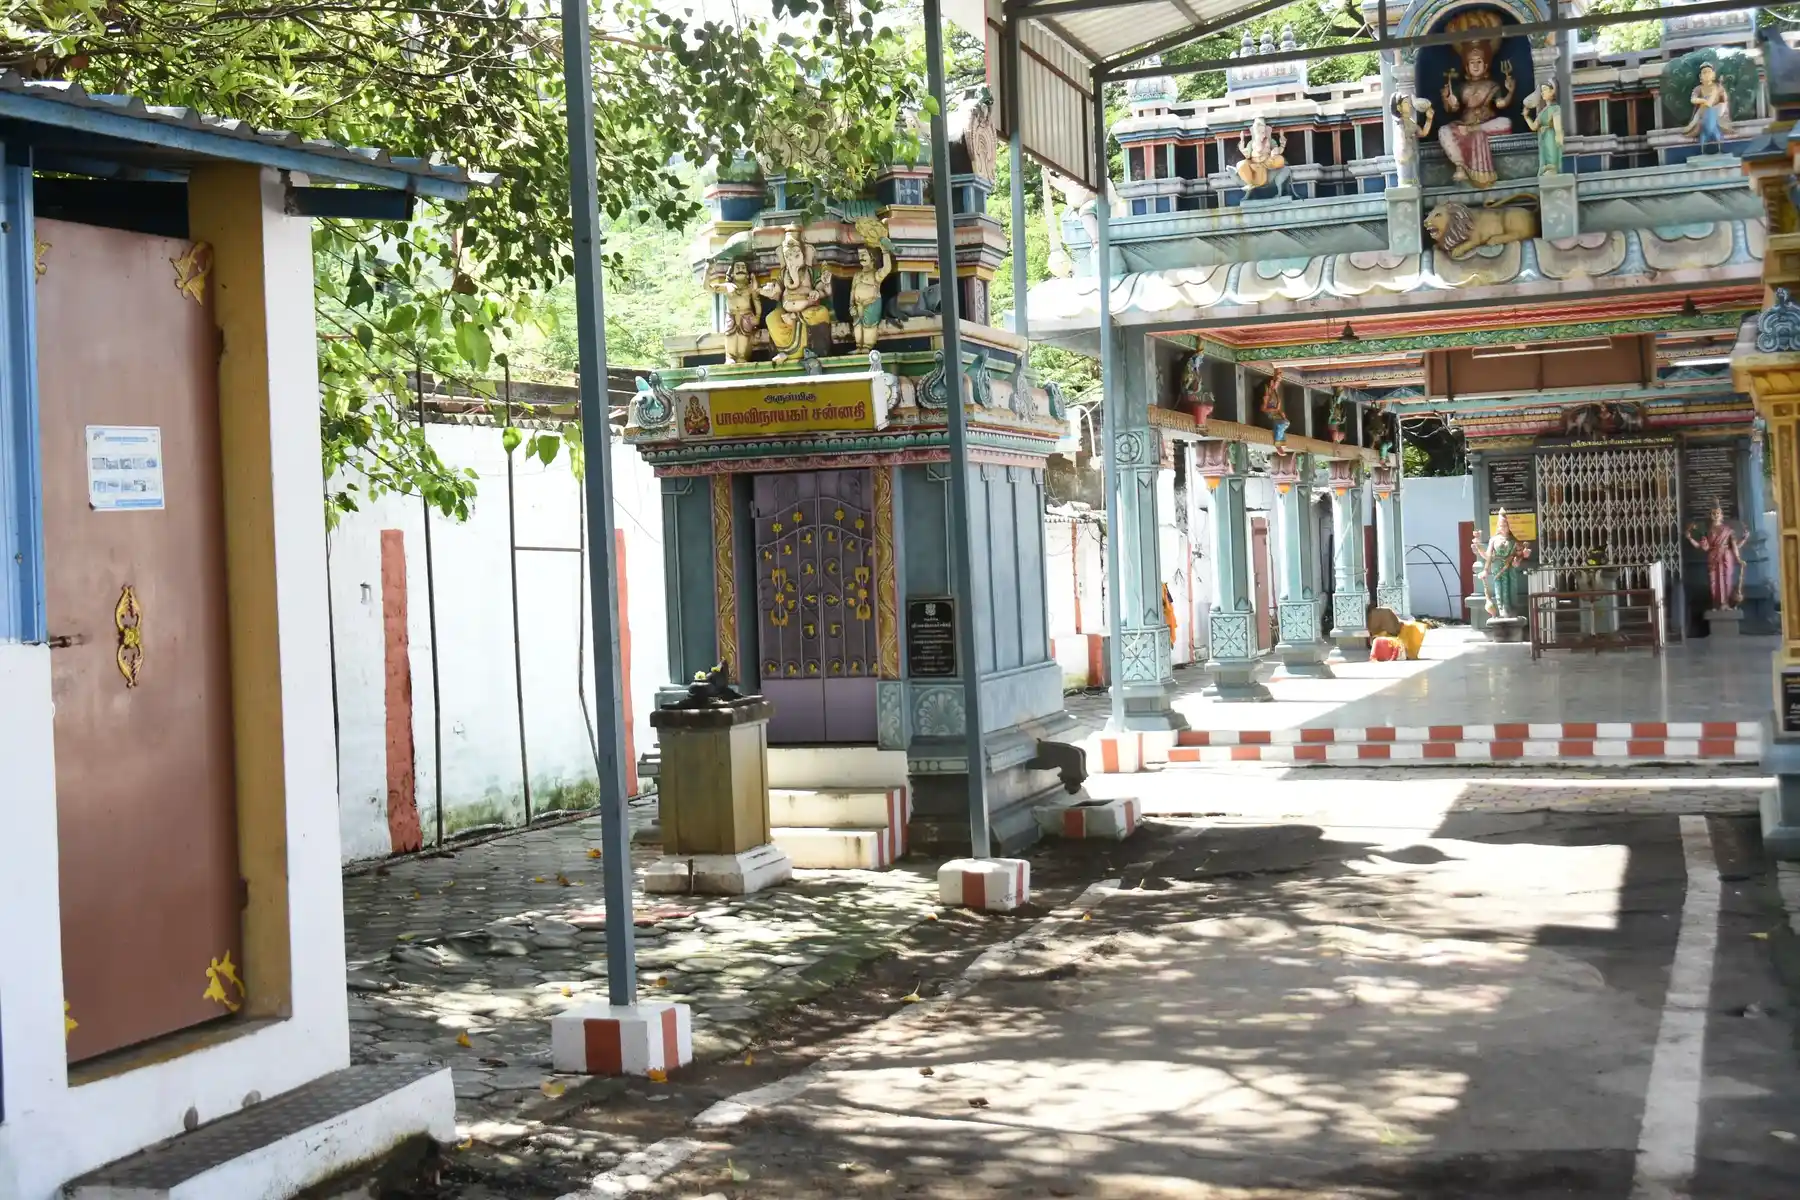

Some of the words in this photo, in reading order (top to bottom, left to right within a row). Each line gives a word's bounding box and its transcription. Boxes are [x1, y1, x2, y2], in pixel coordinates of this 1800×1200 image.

[764, 391, 816, 404] அருள்மிகு
[716, 405, 808, 427] பாலவிநாயகர்
[812, 401, 866, 421] சன்னதி
